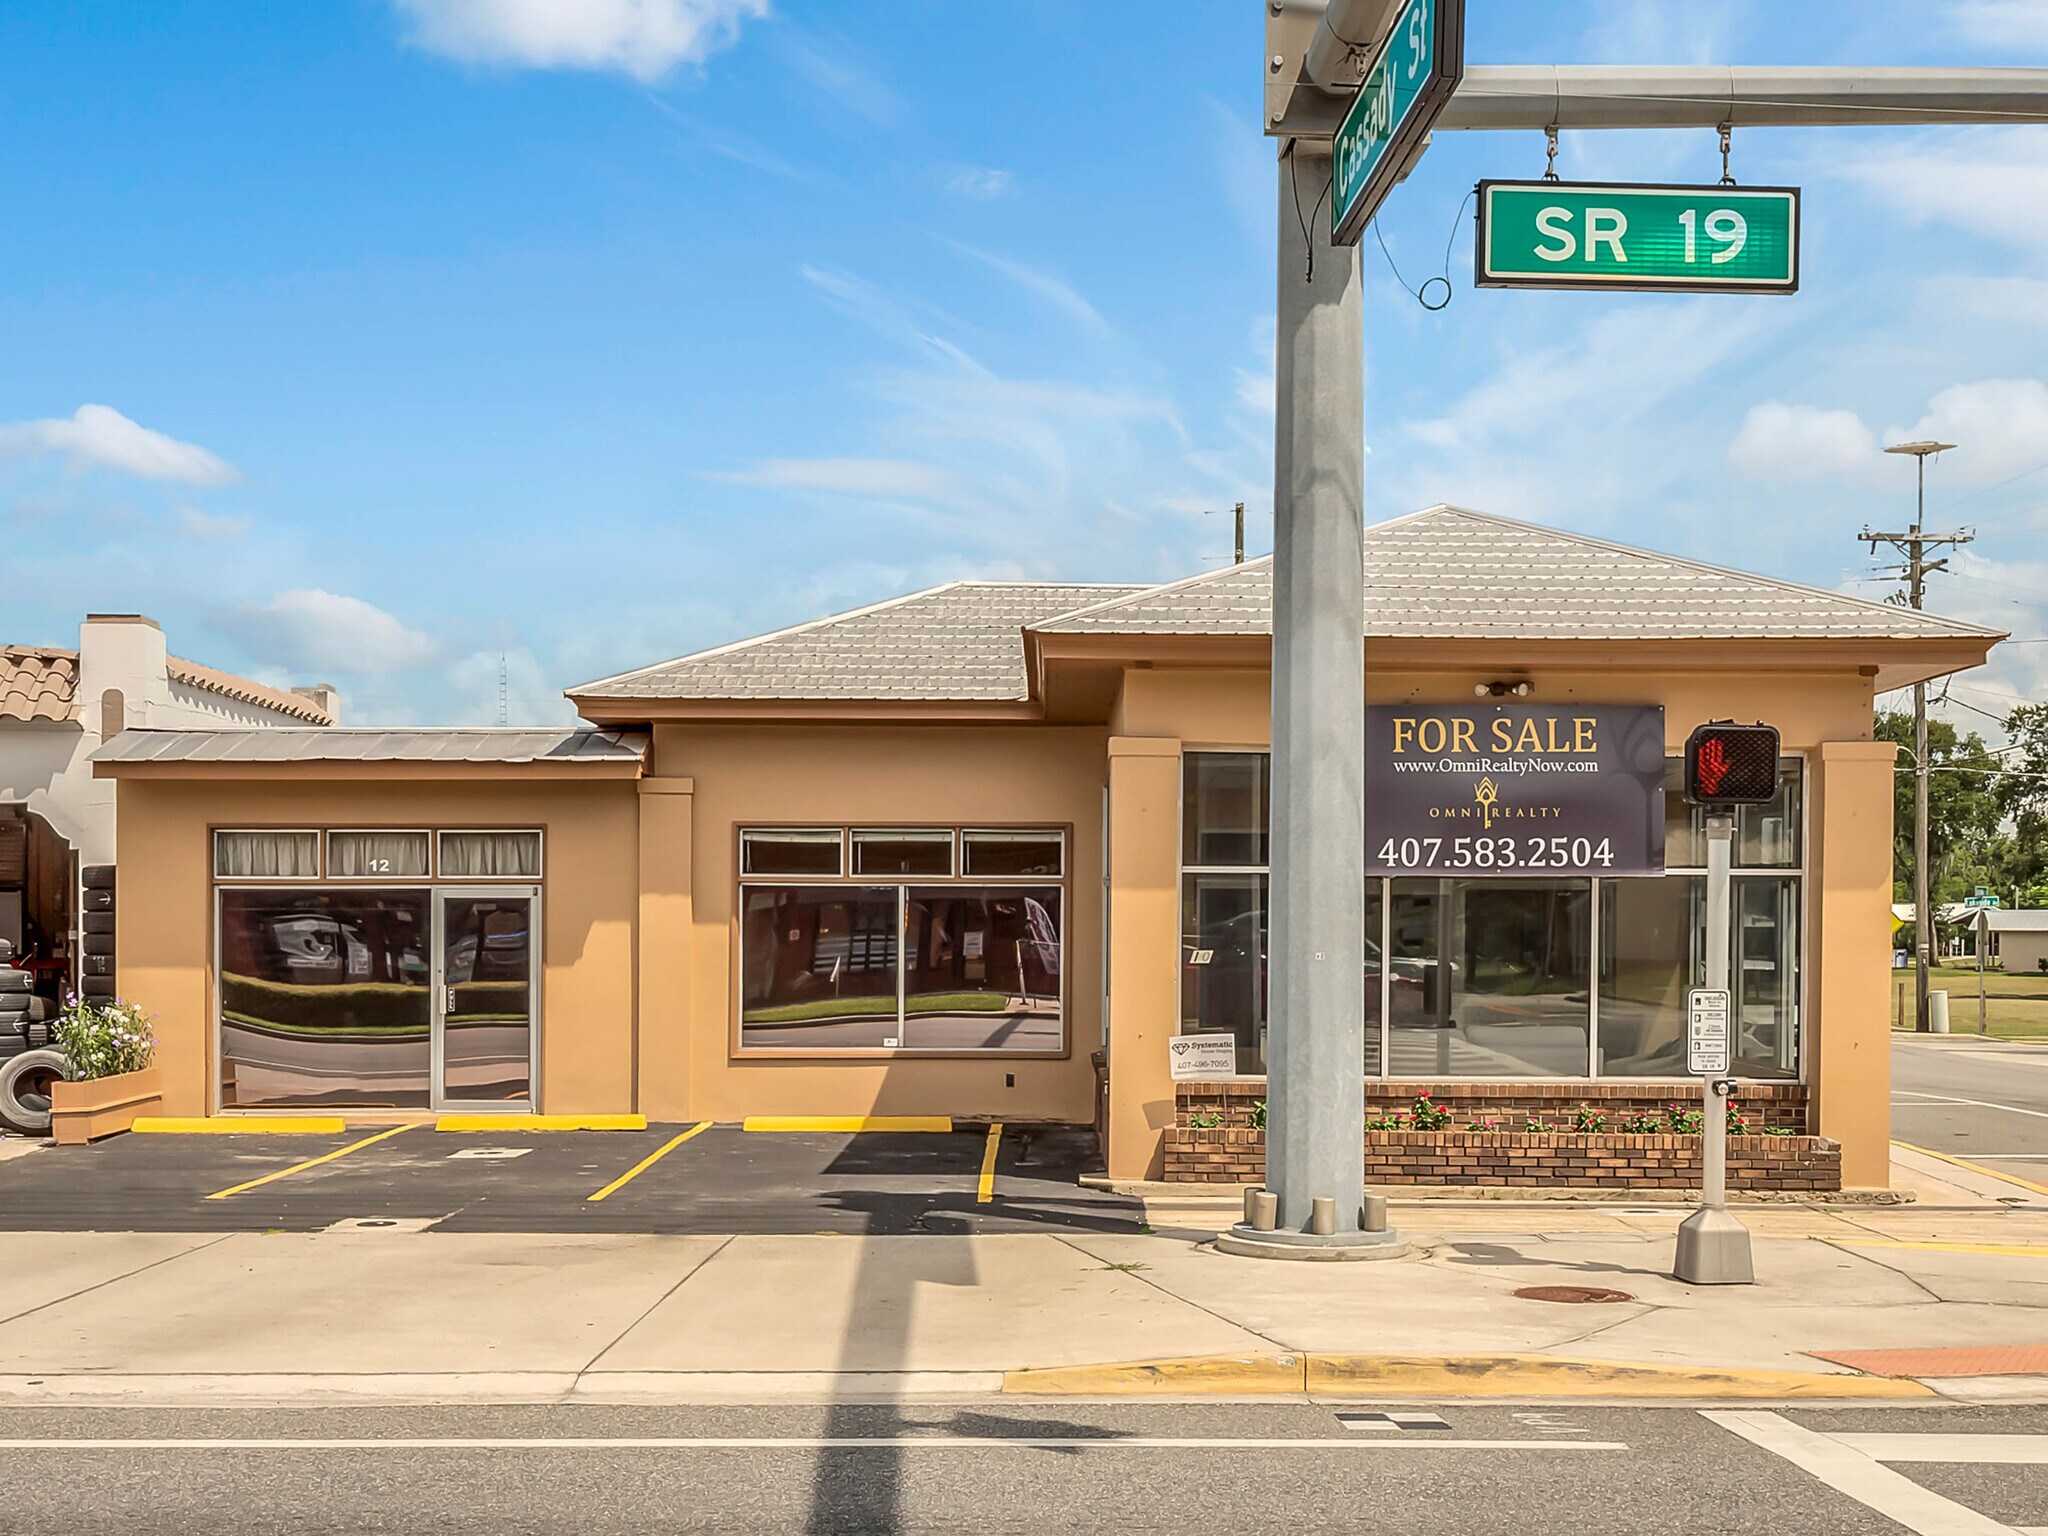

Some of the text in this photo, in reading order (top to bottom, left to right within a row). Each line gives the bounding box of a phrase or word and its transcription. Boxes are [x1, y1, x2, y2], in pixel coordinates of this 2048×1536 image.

[1339, 0, 1428, 198] Cassady St
[1533, 206, 1748, 264] SR 19
[1392, 718, 1598, 753] FOR SALE
[1393, 758, 1599, 777] www.OmniRealtyNow.com
[1429, 807, 1562, 818] OMNI REALTY
[1377, 837, 1614, 868] 407.583.2504
[369, 859, 390, 872] 12
[1193, 951, 1211, 962] 10
[1191, 1041, 1233, 1050] Systematic
